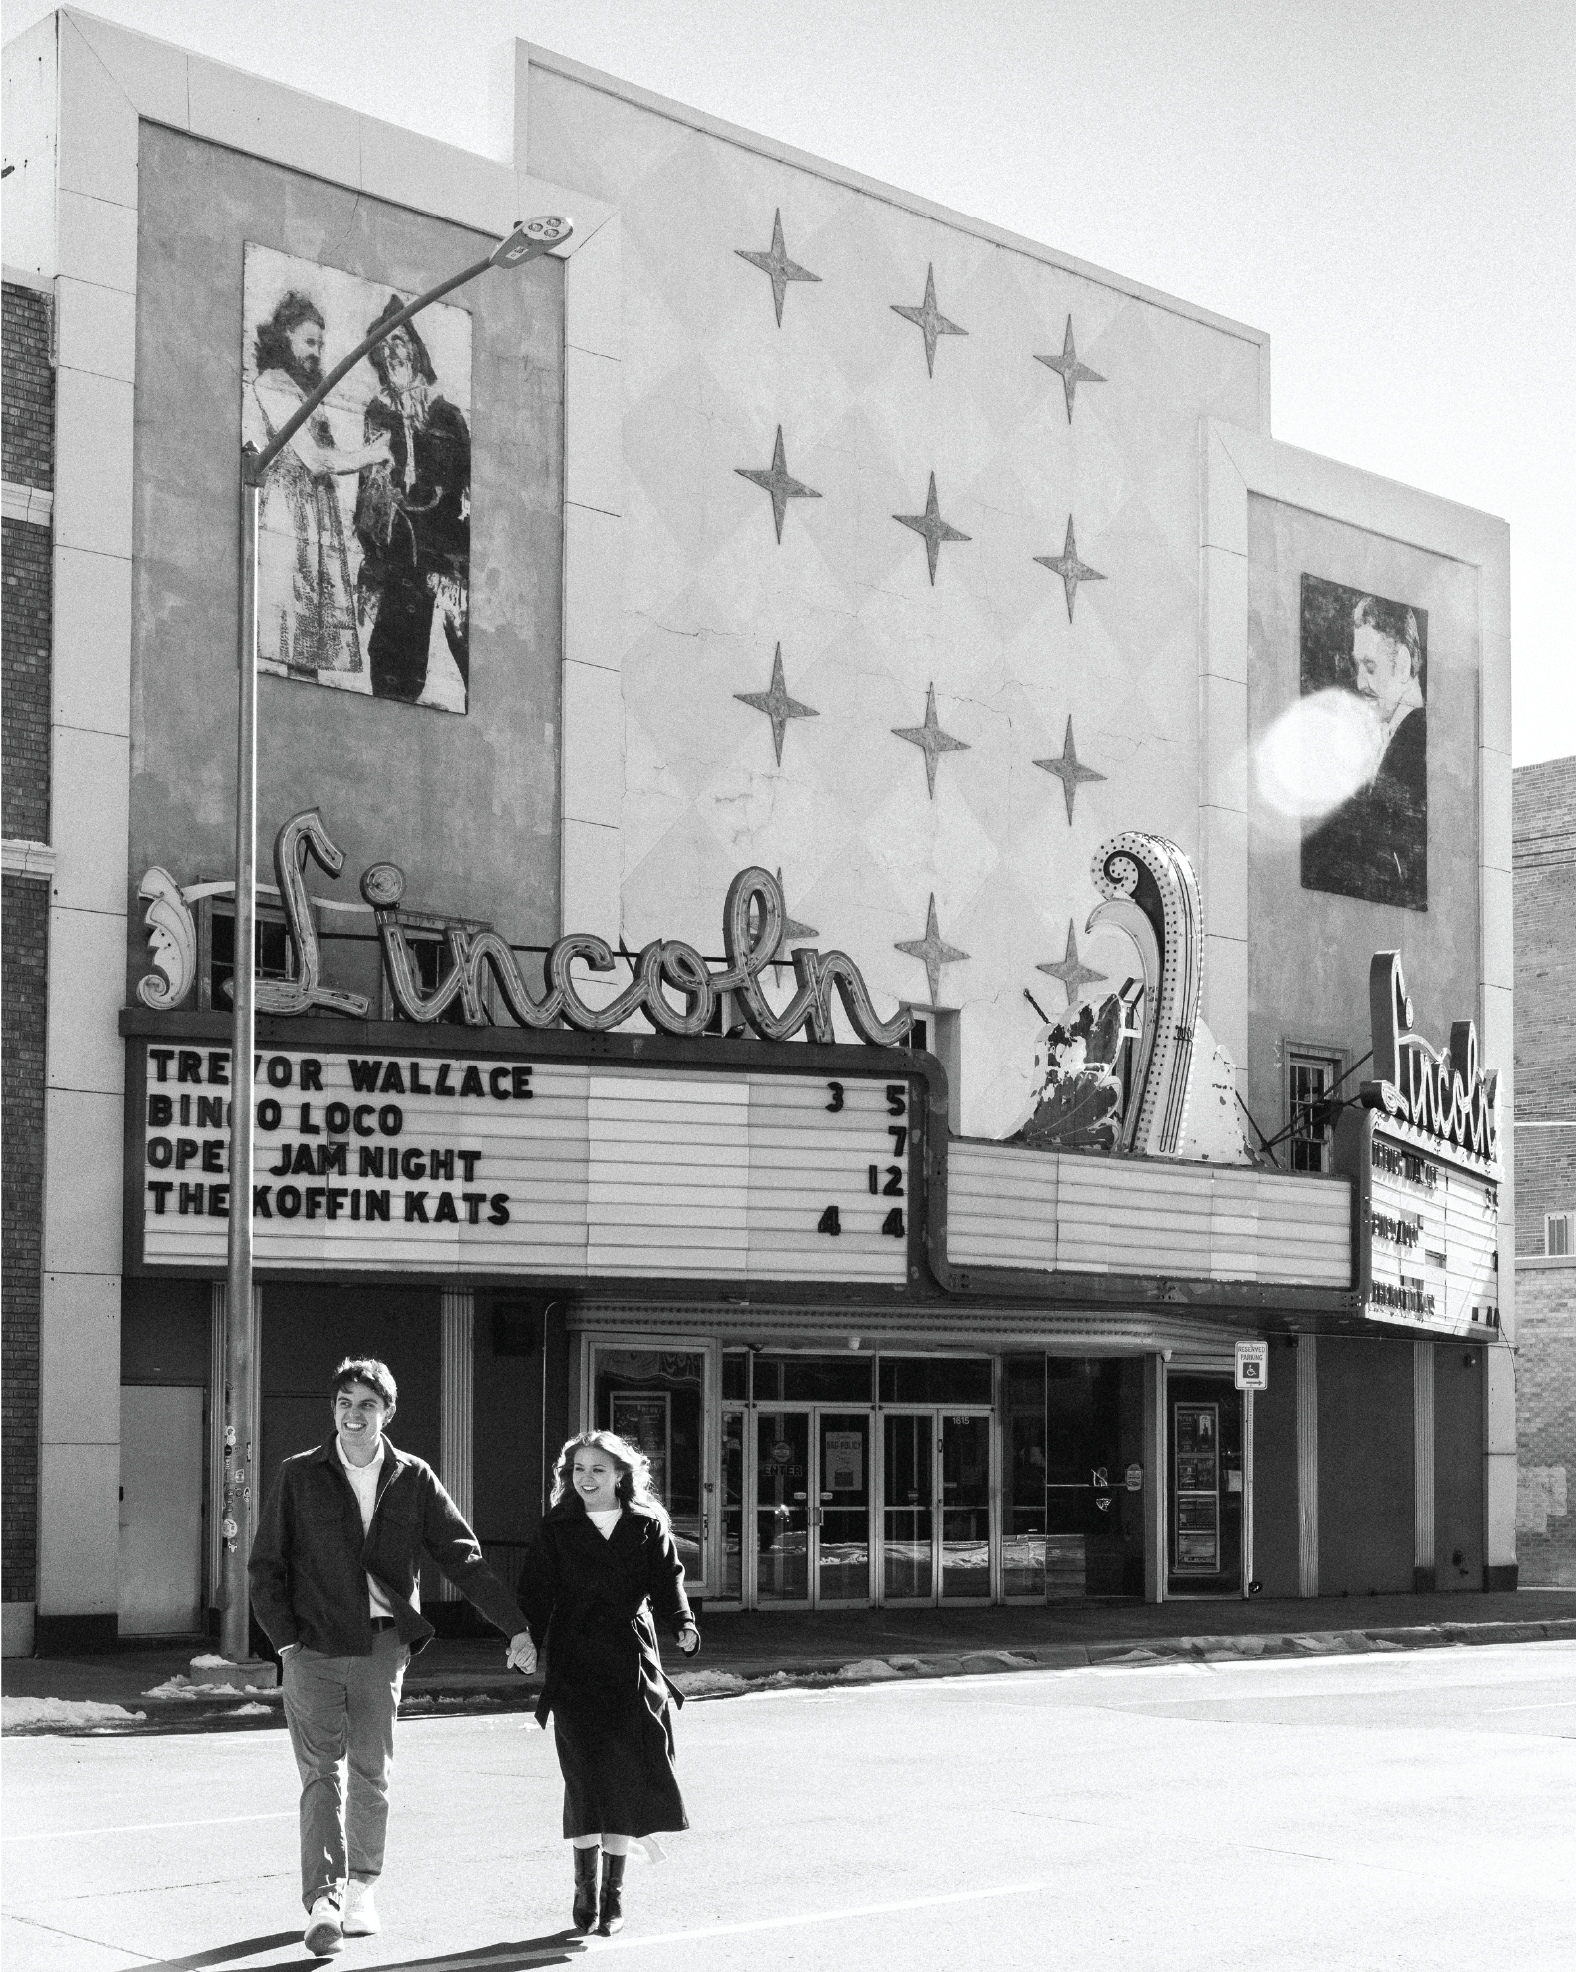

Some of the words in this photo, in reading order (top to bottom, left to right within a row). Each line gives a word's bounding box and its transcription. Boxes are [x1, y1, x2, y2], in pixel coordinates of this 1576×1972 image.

[222, 806, 915, 1047] Lincoln
[149, 1048, 324, 1091] TREOR
[347, 1059, 533, 1100] WALLACE
[825, 1081, 844, 1112] 3
[886, 1085, 906, 1116] 5
[148, 1093, 282, 1131] BINO
[300, 1101, 403, 1137] LOCO
[888, 1125, 907, 1157] 7
[147, 1136, 231, 1174] OPE
[269, 1143, 347, 1176] JAM
[358, 1145, 482, 1182] NIGHT
[868, 1165, 904, 1197] 12
[148, 1181, 230, 1215] THE
[251, 1184, 391, 1222] KOFFIN
[405, 1190, 510, 1226] KATS
[818, 1205, 841, 1236] 4
[882, 1207, 905, 1238] 4
[1240, 1353, 1263, 1361] PARKING
[952, 1416, 970, 1425] 1615
[763, 1464, 803, 1477] ENTER
